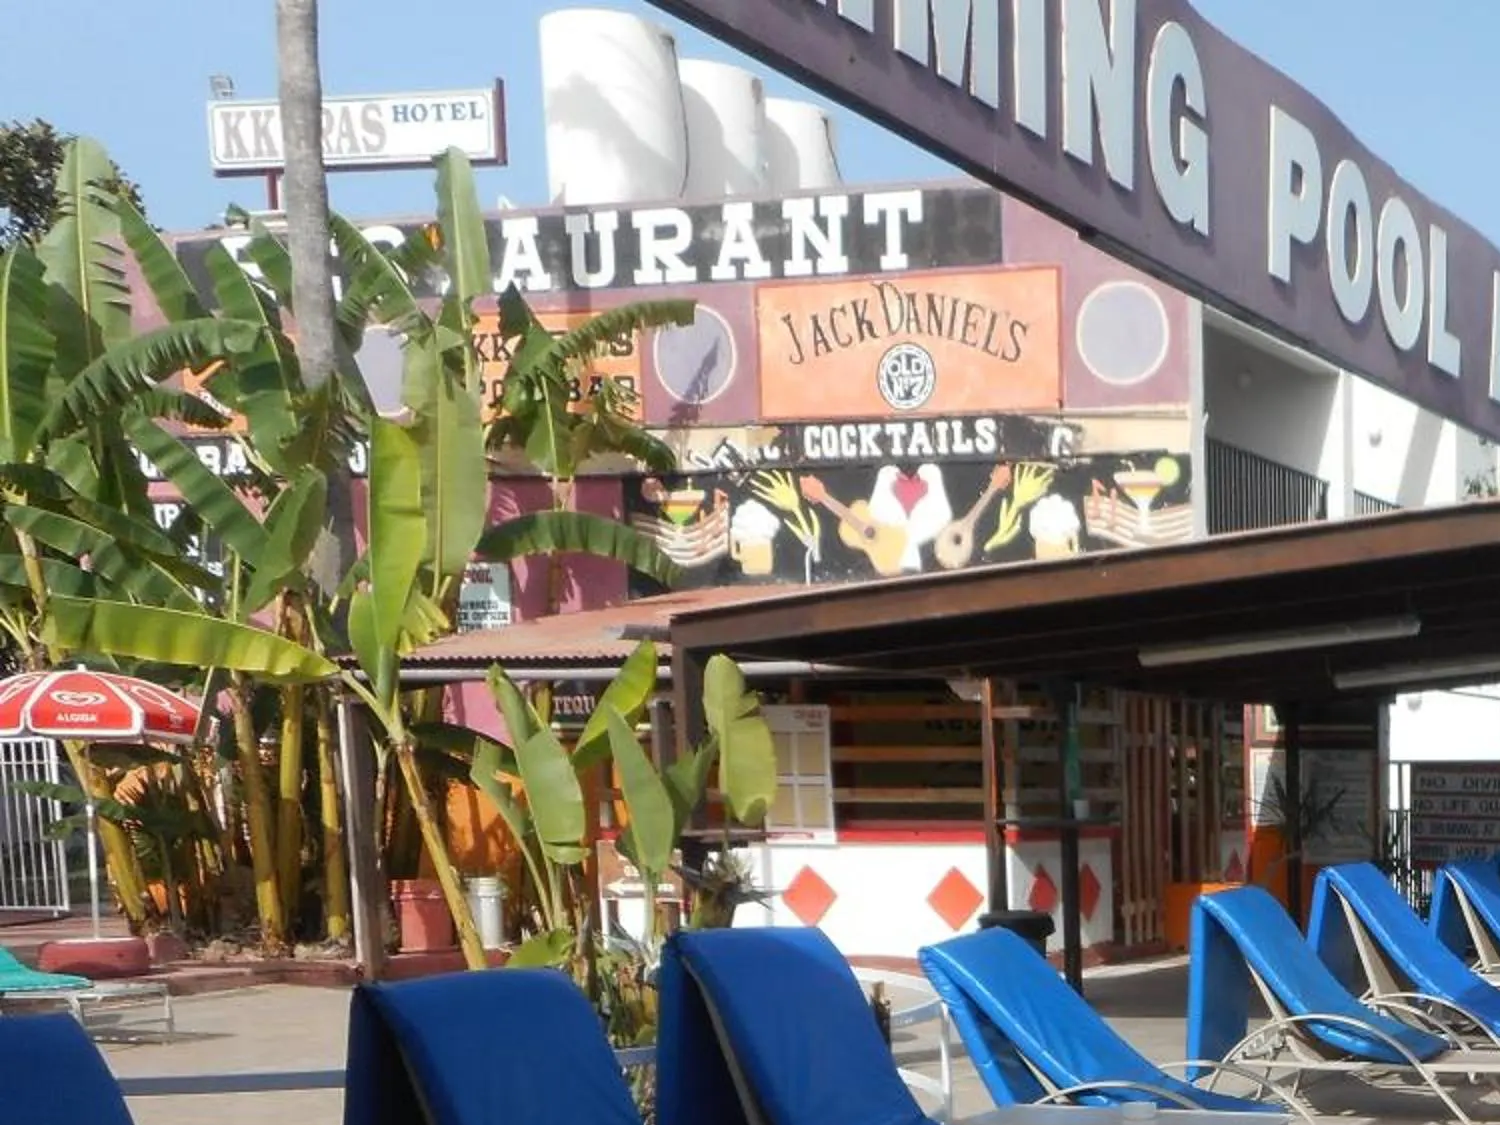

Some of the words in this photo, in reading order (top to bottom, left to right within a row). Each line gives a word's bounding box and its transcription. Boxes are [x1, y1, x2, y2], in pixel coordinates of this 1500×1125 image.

[391, 101, 485, 123] HOTEL
[1267, 103, 1461, 378] POOL
[781, 298, 879, 366] JACK
[887, 353, 926, 377] OLD
[803, 418, 997, 458] COCKTAILS
[1419, 776, 1446, 788] NO
